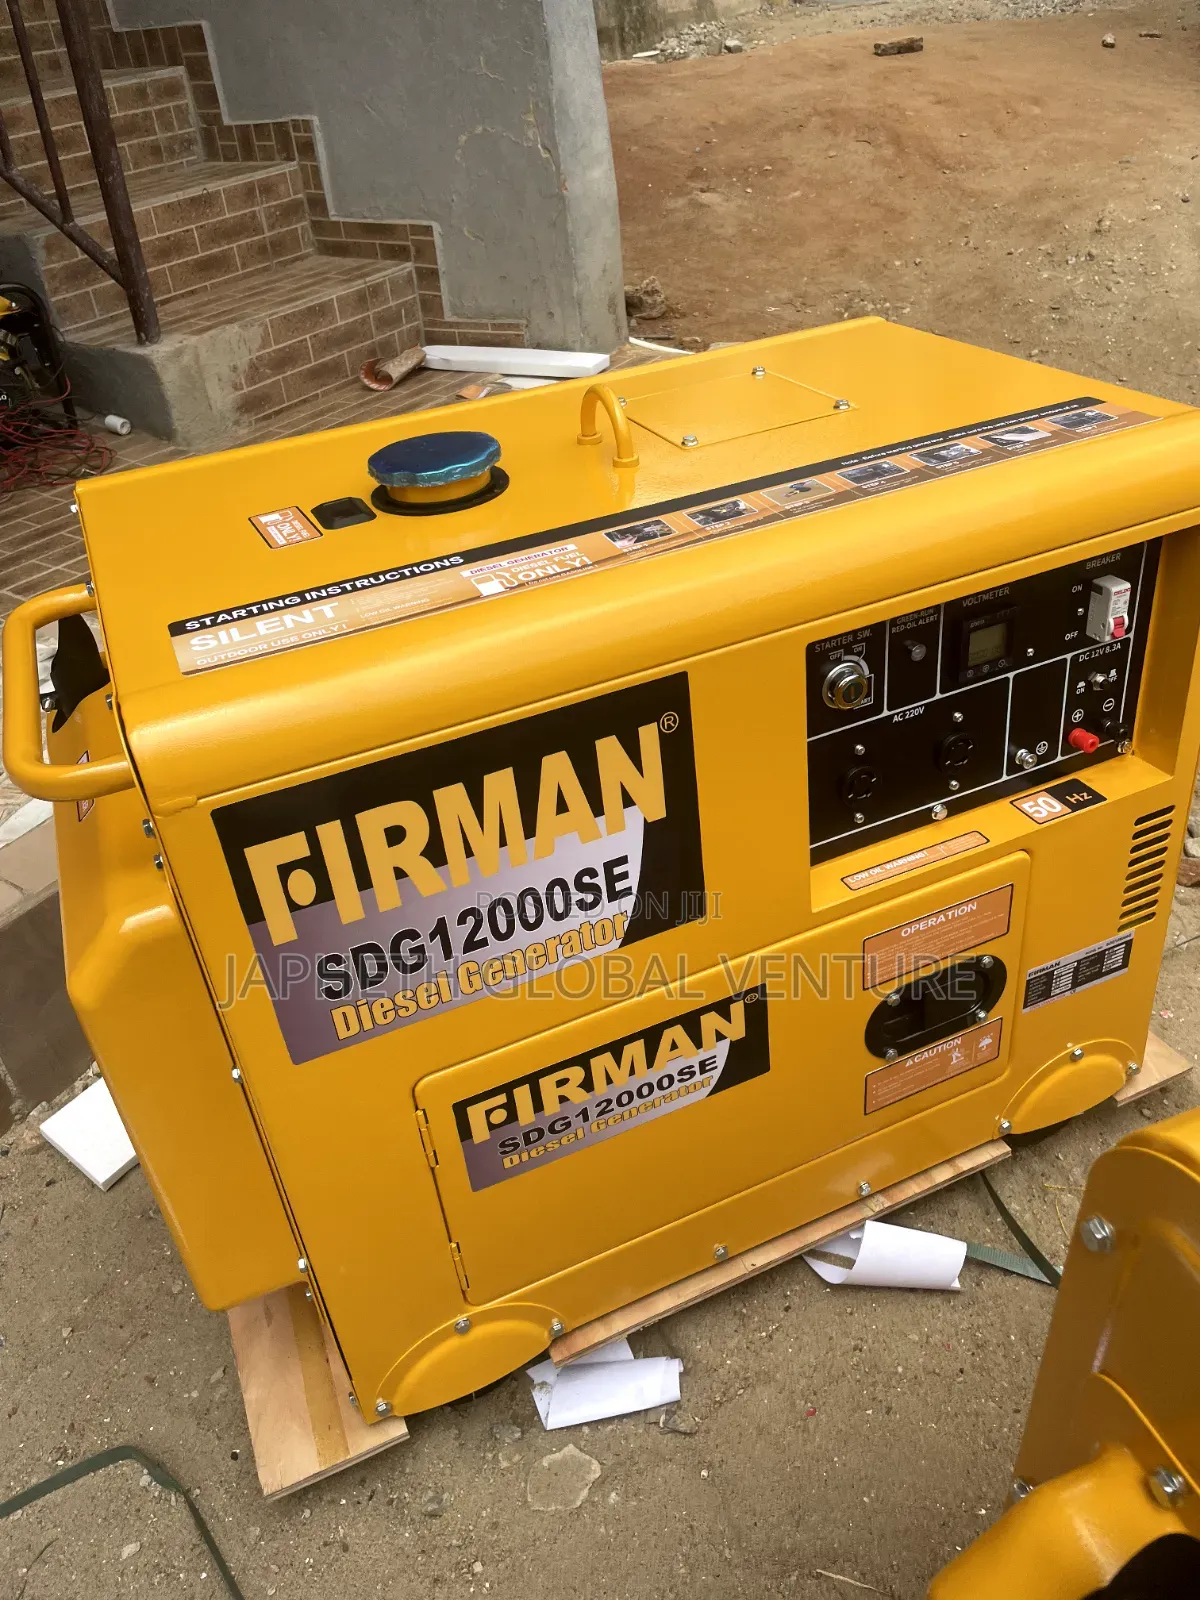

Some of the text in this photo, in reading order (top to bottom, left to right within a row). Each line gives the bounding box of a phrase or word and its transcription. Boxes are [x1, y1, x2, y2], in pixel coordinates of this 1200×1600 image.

[470, 546, 569, 575] DIESEL GENERATOR
[511, 551, 585, 573] DIESEL FUEL
[517, 556, 593, 582] ONLY!
[1085, 552, 1121, 570] BREAKER
[185, 596, 301, 631] STARTING
[304, 556, 464, 601] INSTRUCTIONS
[962, 586, 1010, 608] VOLTMETER
[1071, 584, 1083, 594] ON
[189, 602, 339, 651] SILENT
[891, 614, 939, 634] RED-OIL ALERT
[1064, 630, 1079, 641] OFF
[196, 643, 269, 666] OUTDOOR
[270, 635, 300, 647] USE
[814, 628, 873, 653] STARTER SW.
[1079, 642, 1121, 662] DC 12V 8.3A
[1076, 687, 1085, 695] ON
[892, 705, 925, 724] AC 220V
[1020, 791, 1093, 818] 50 Hz
[244, 721, 667, 948] FIRMAN
[847, 850, 928, 884] LOW OIL WARNING!
[316, 854, 634, 1003] SDG12000SE
[901, 902, 978, 937] OPERATION
[330, 908, 630, 1042] Diesel Generator
[1028, 961, 1060, 978] FIRMAN
[914, 1037, 962, 1064] CAUTION
[466, 1000, 746, 1145] FIRMAN
[498, 1055, 719, 1157] SDG12000SE
[501, 1075, 715, 1170] Diesel Generator
